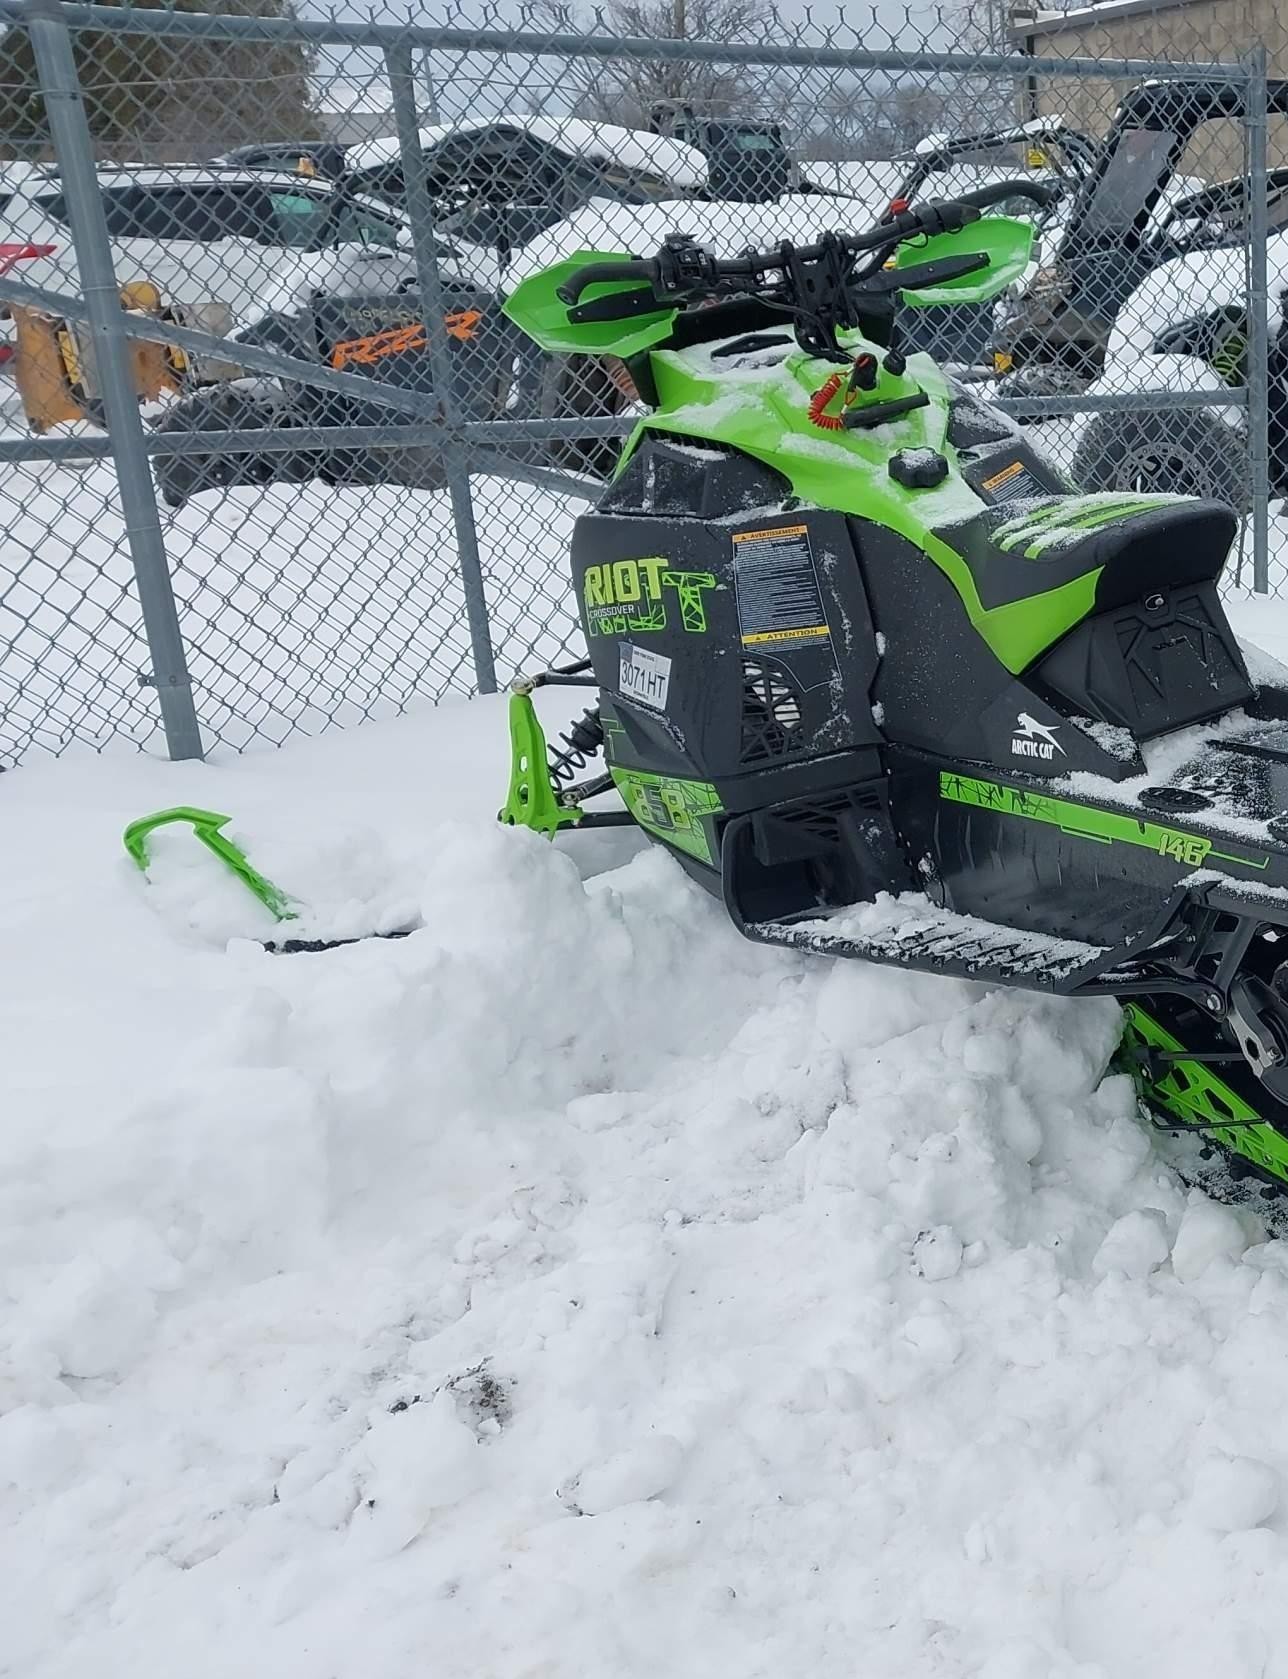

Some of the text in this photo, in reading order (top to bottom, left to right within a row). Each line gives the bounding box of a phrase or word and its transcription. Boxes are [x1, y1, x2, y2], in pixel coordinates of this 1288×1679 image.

[750, 527, 801, 539] AVERTISSEMENT
[584, 557, 669, 607] RIOT
[589, 604, 635, 619] CROSSOVER
[767, 628, 818, 640] ATTENTION
[1011, 738, 1054, 760] ARCTIC CAT
[1159, 833, 1204, 867] 146
